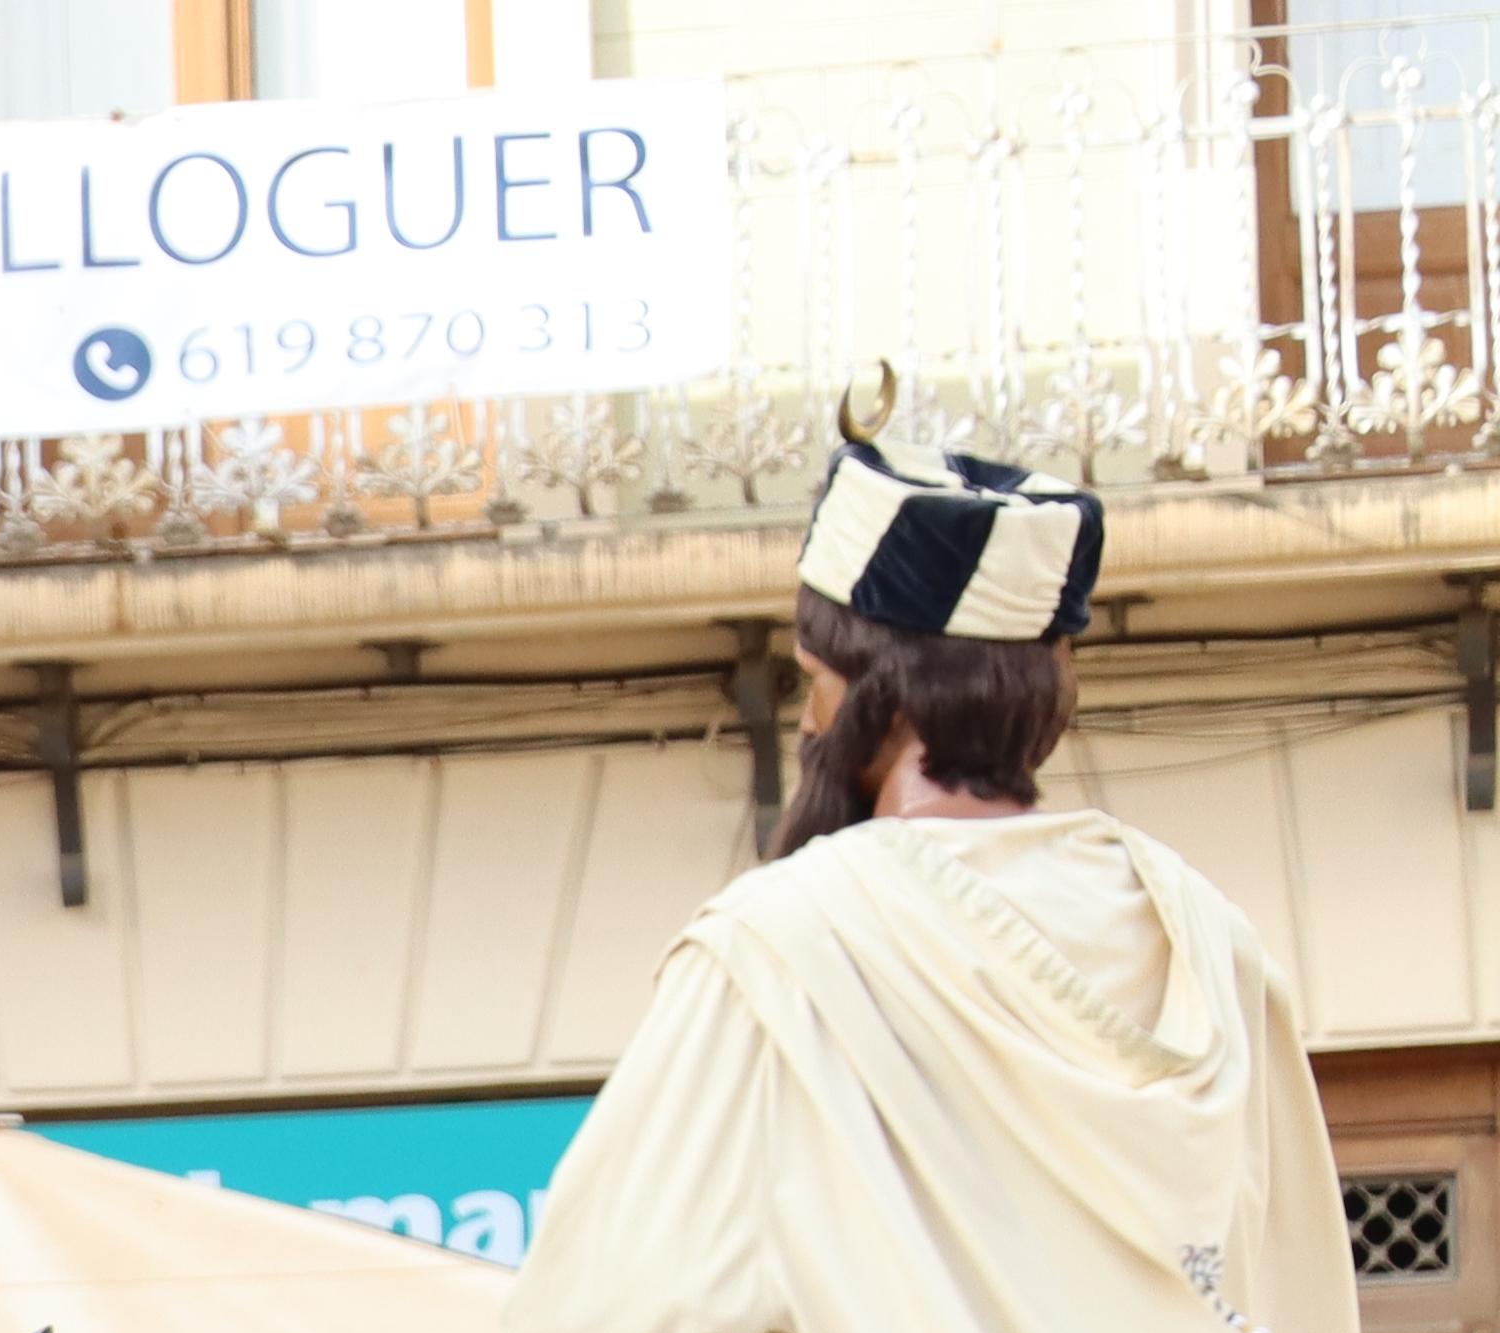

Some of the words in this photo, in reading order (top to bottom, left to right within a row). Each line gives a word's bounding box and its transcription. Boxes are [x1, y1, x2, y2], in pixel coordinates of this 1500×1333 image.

[0, 126, 653, 273] LLOGUER
[178, 319, 317, 383] 619
[345, 310, 485, 365] 870
[517, 299, 652, 353] 313
